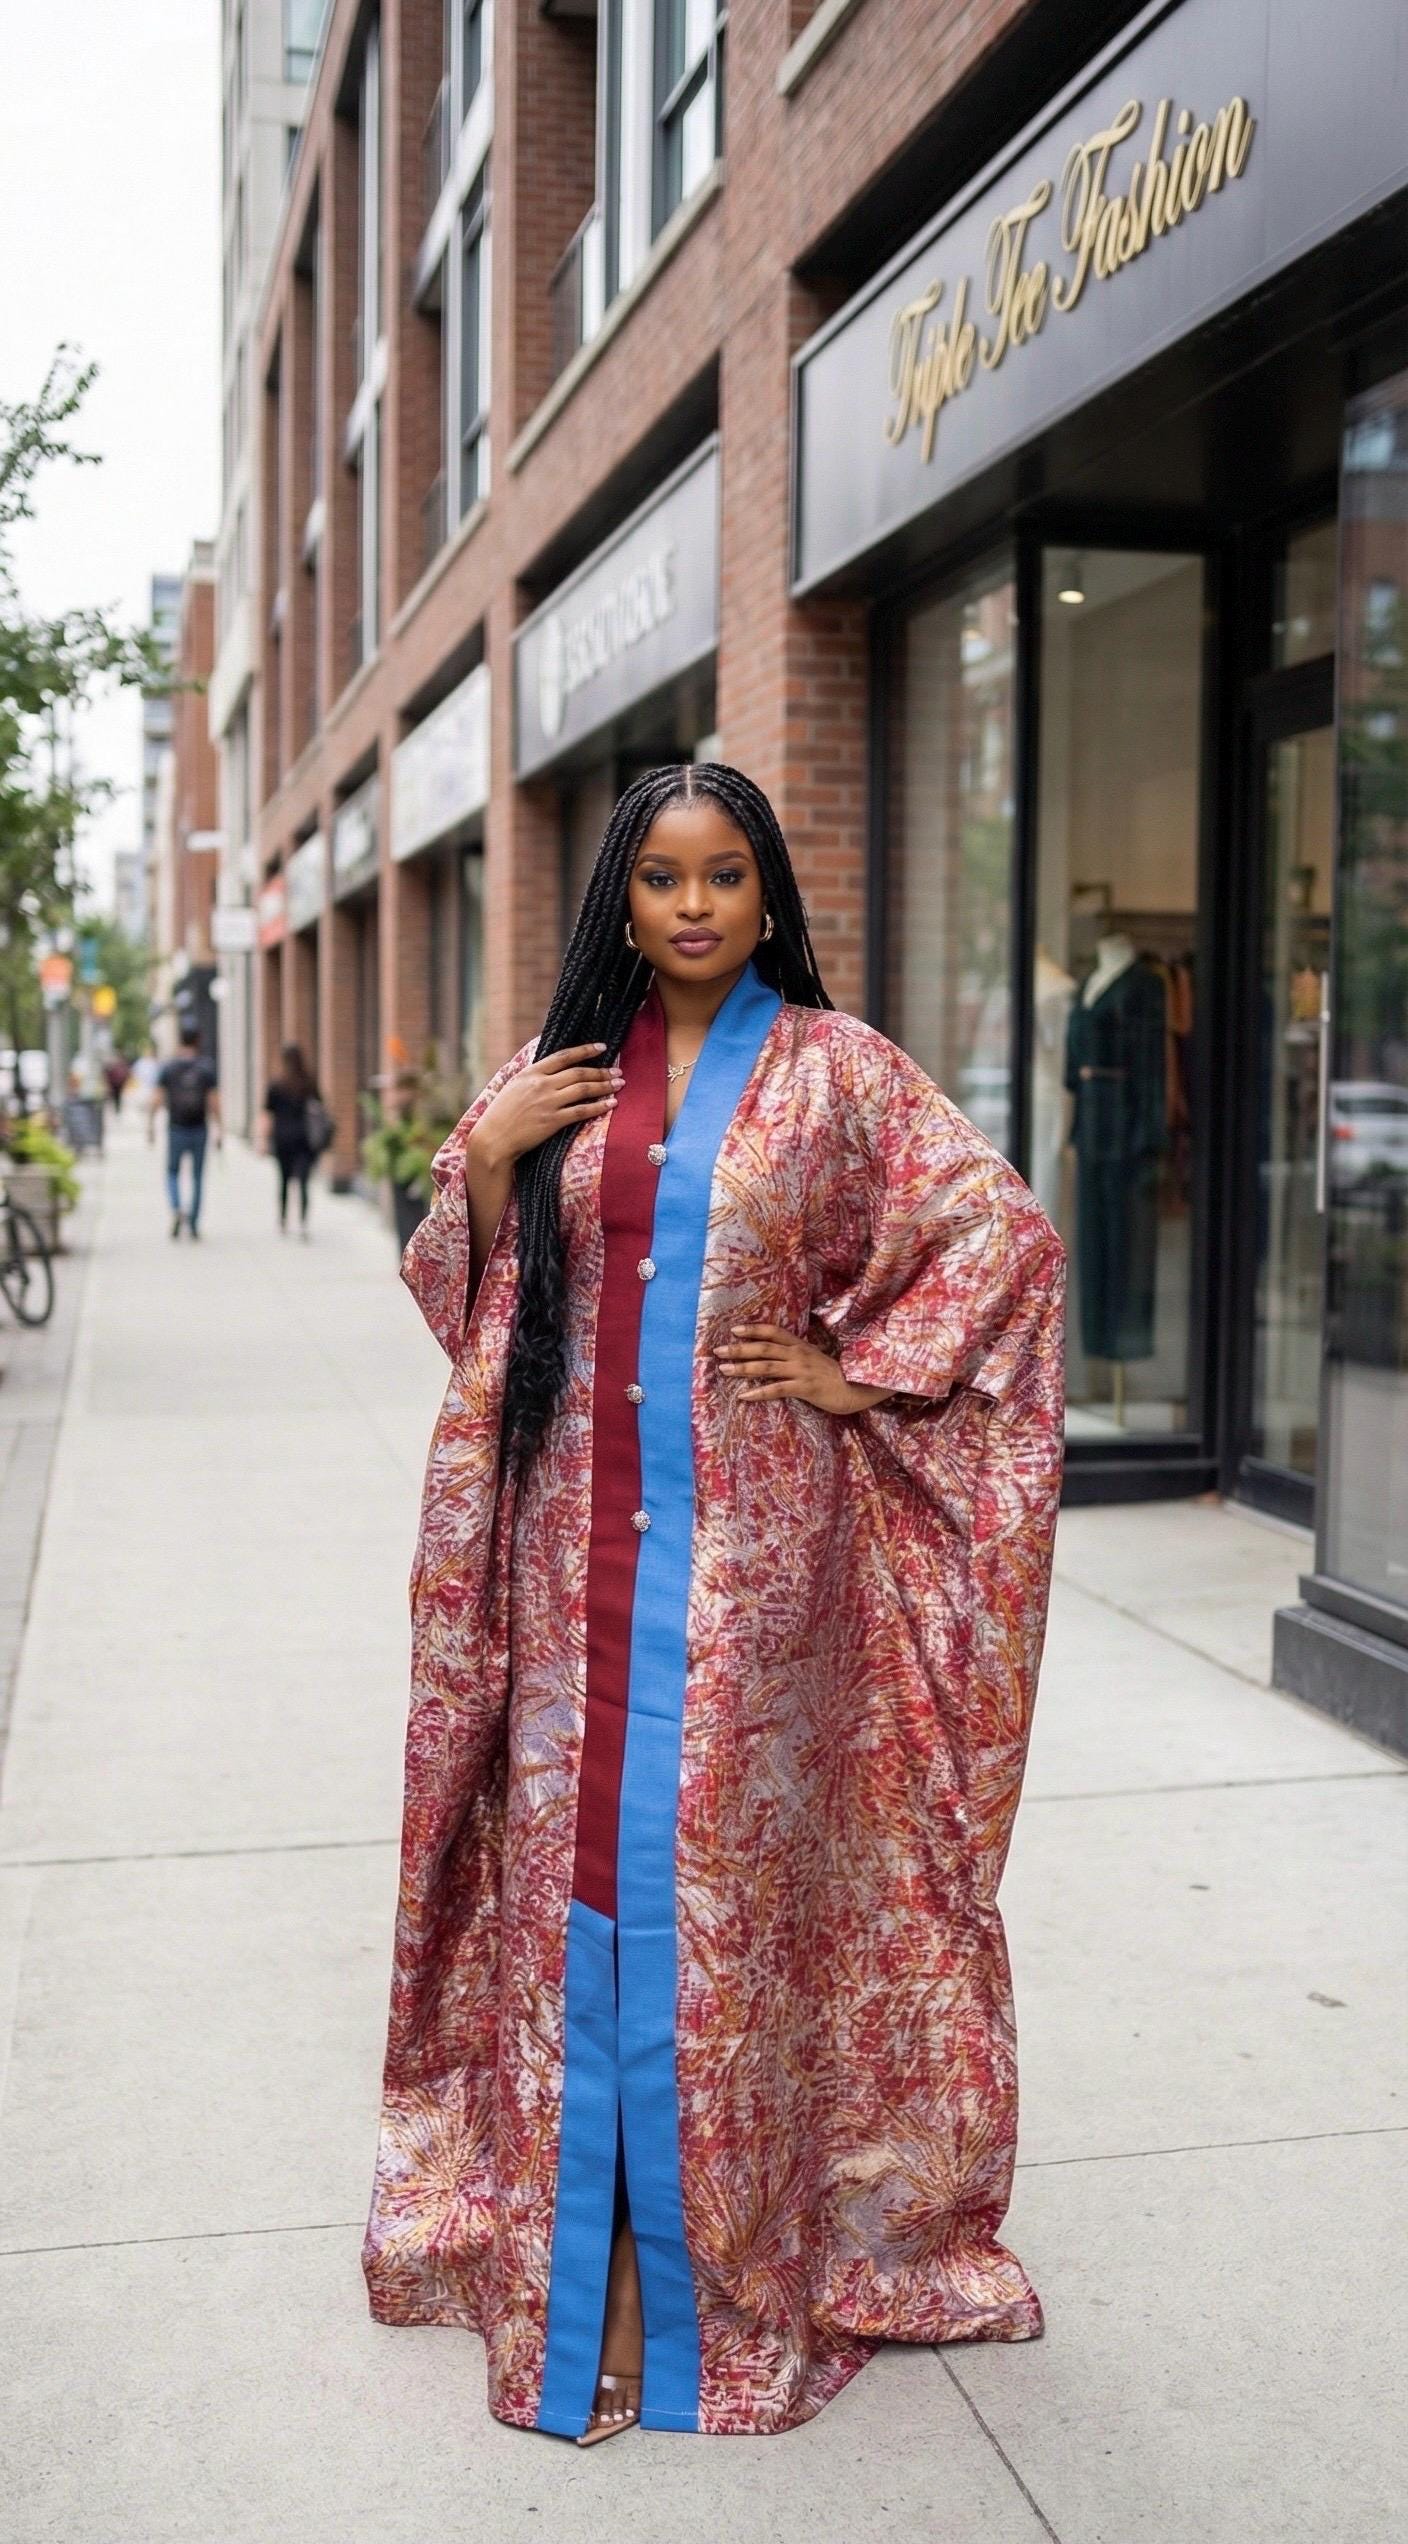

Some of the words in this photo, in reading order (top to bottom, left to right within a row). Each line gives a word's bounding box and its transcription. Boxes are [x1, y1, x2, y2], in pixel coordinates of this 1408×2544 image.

[884, 276, 976, 463] Triple
[980, 179, 1051, 369] Tee
[1053, 96, 1256, 310] Fashion
